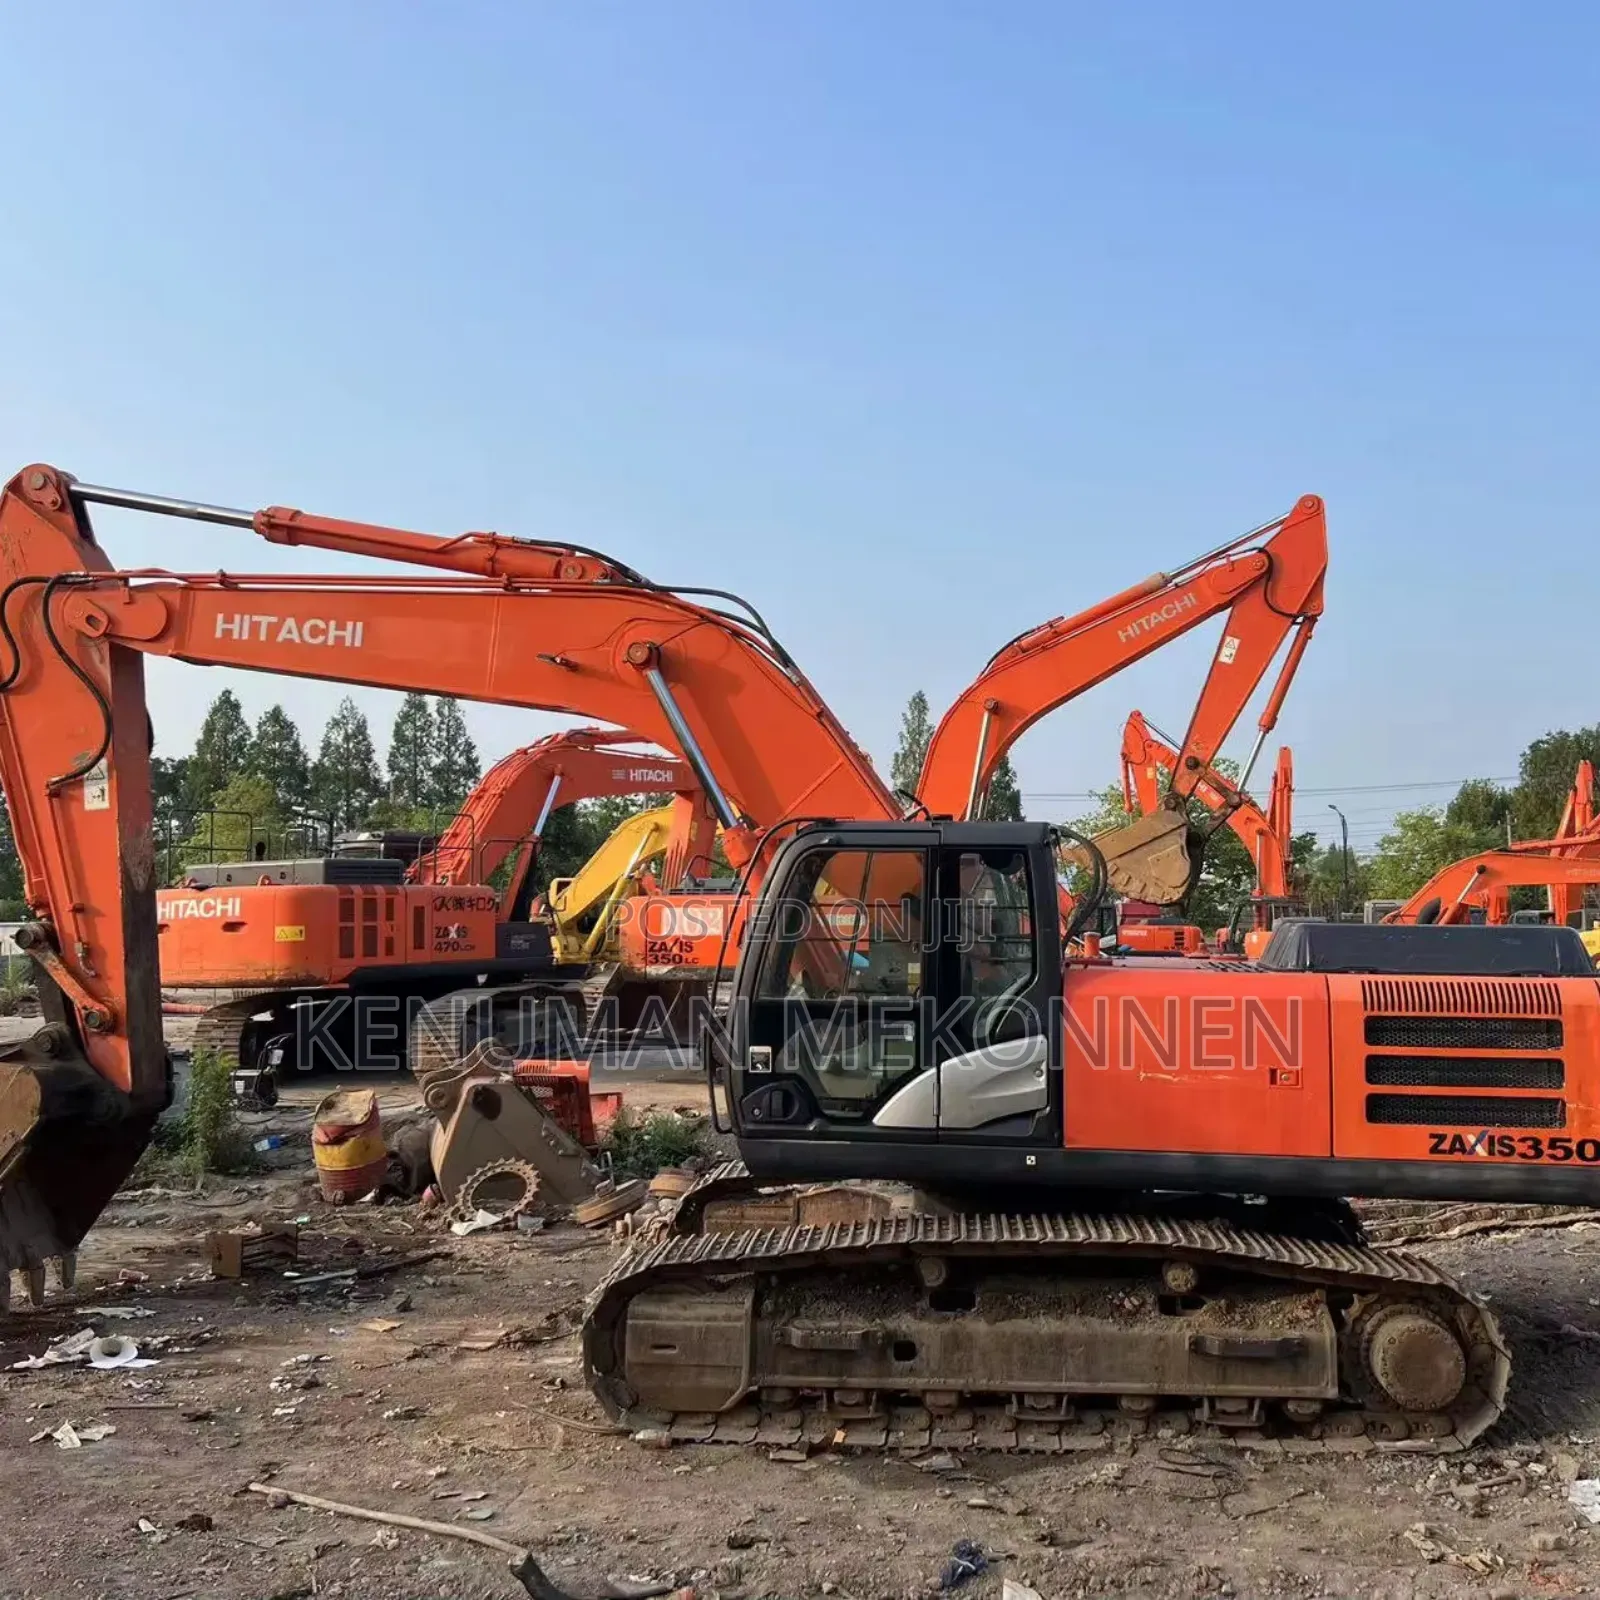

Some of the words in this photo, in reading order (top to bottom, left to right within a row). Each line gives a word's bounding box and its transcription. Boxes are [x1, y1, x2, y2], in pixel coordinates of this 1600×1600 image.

[1117, 593, 1197, 643] HITACHI
[215, 613, 364, 647] HITACHI
[630, 769, 673, 782] HITACHI
[157, 898, 241, 919] HITACHI
[434, 923, 468, 939] ZAXIS
